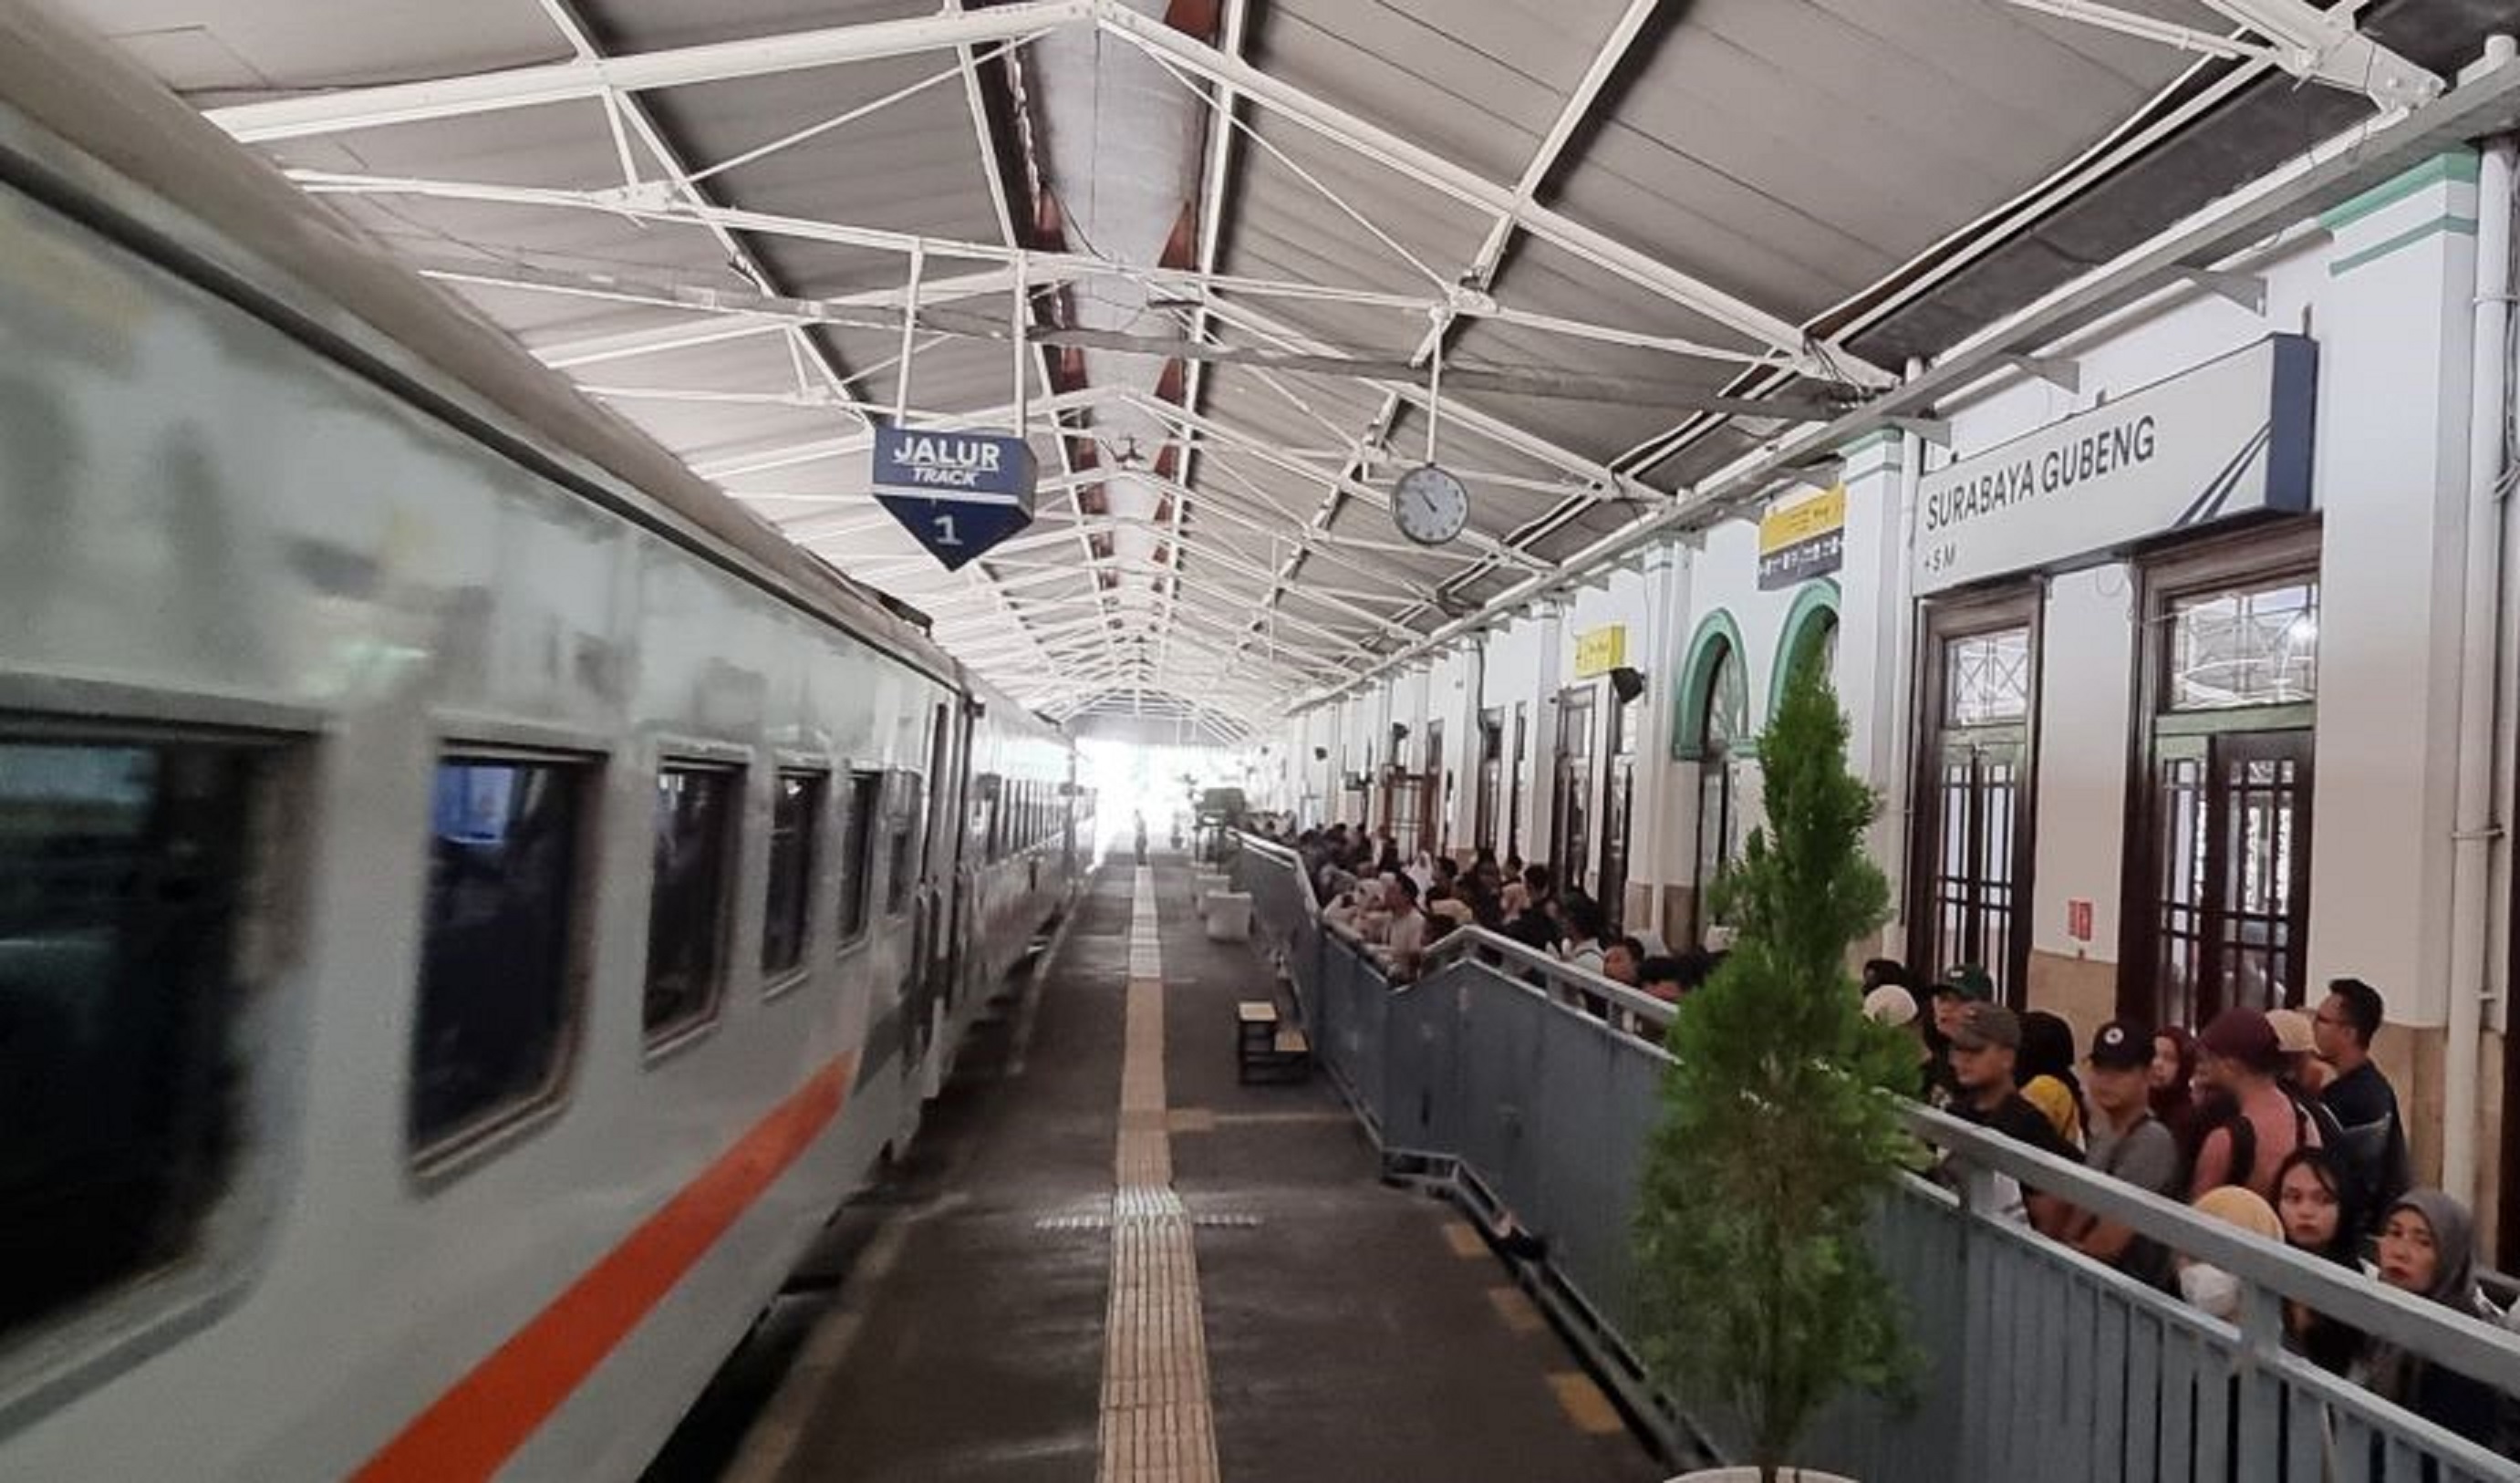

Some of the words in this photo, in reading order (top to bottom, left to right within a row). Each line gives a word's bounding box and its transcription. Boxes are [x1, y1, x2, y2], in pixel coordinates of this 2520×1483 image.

[893, 437, 1000, 472] JALUR
[913, 468, 980, 486] TRACK
[1926, 460, 2034, 530] SURABAYA
[2042, 416, 2154, 493] GUBENG
[933, 514, 963, 545] 1
